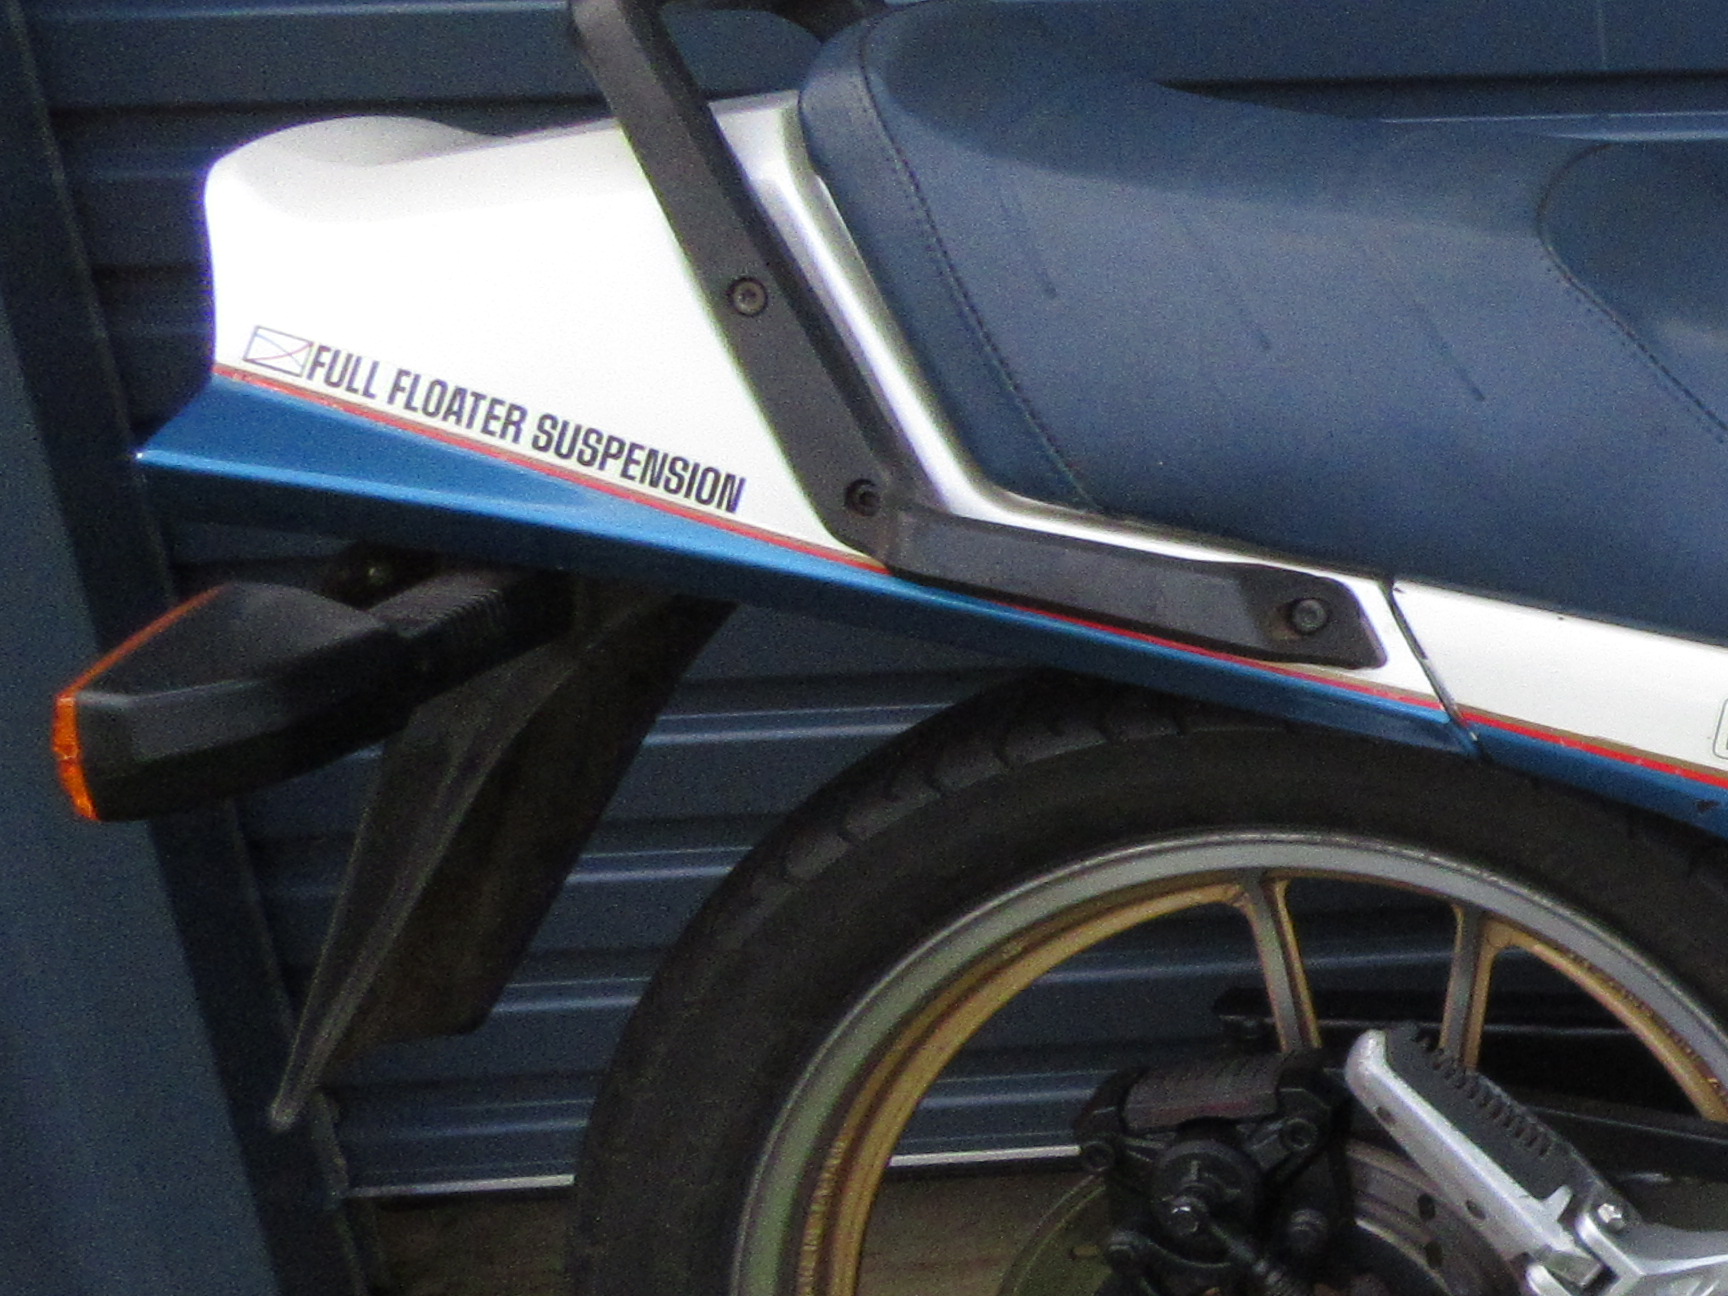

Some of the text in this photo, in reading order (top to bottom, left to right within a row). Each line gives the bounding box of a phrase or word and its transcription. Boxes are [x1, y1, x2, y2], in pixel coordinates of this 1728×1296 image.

[306, 344, 747, 515] FULL FLOATER SUSPENSION
